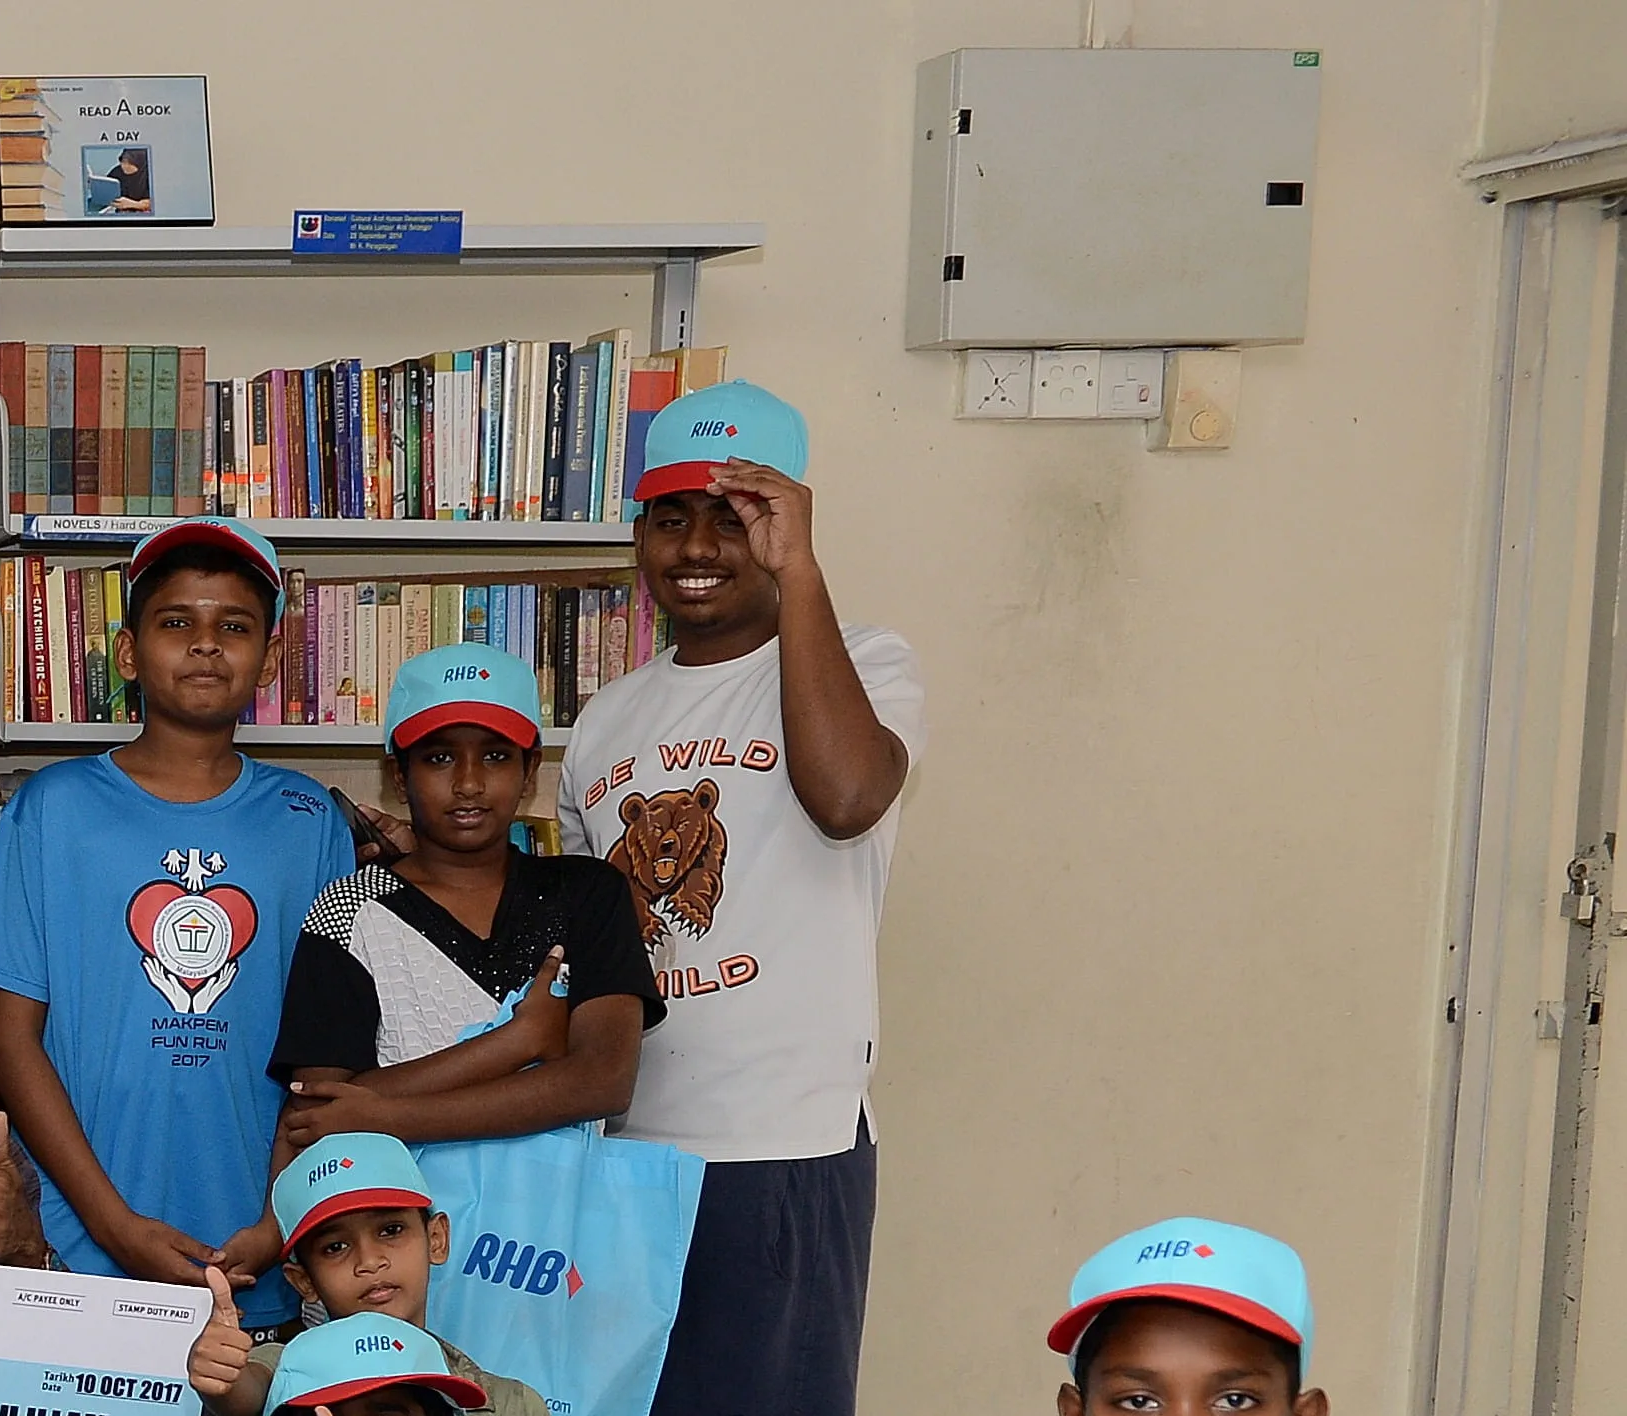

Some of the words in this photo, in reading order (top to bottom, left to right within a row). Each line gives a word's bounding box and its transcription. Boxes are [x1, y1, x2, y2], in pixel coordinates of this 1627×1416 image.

[1295, 53, 1317, 65] EPS
[79, 106, 111, 117] READ
[117, 99, 132, 116] A
[136, 105, 171, 116] BOOK
[100, 132, 109, 141] A
[117, 132, 140, 141] DAY
[691, 421, 725, 438] RHB
[53, 519, 101, 531] NOVELS
[111, 519, 137, 531] Hard
[32, 598, 45, 651] CATCHING
[443, 666, 479, 684] RHB
[585, 757, 637, 810] BE
[659, 738, 780, 773] WILD
[280, 789, 328, 812] BROOKS
[151, 1018, 229, 1034] MAKPEM
[151, 1036, 188, 1049] FUN
[193, 1037, 227, 1052] RUN
[171, 1055, 211, 1067] 2017
[307, 1158, 341, 1187] RHB
[1136, 1240, 1190, 1265] RHB
[462, 1231, 567, 1297] RHB
[17, 1293, 32, 1303] A/C
[34, 1295, 57, 1305] PAYEE
[59, 1297, 80, 1307] ONLY
[118, 1304, 145, 1314] STAMP
[147, 1306, 168, 1317] DUTY
[170, 1308, 190, 1319] PAID
[355, 1335, 392, 1355] RHB
[44, 1371, 75, 1383] Tarikh
[42, 1382, 62, 1393] Date
[75, 1373, 93, 1393] 10
[101, 1376, 136, 1398] OCT
[141, 1379, 184, 1403] 2017
